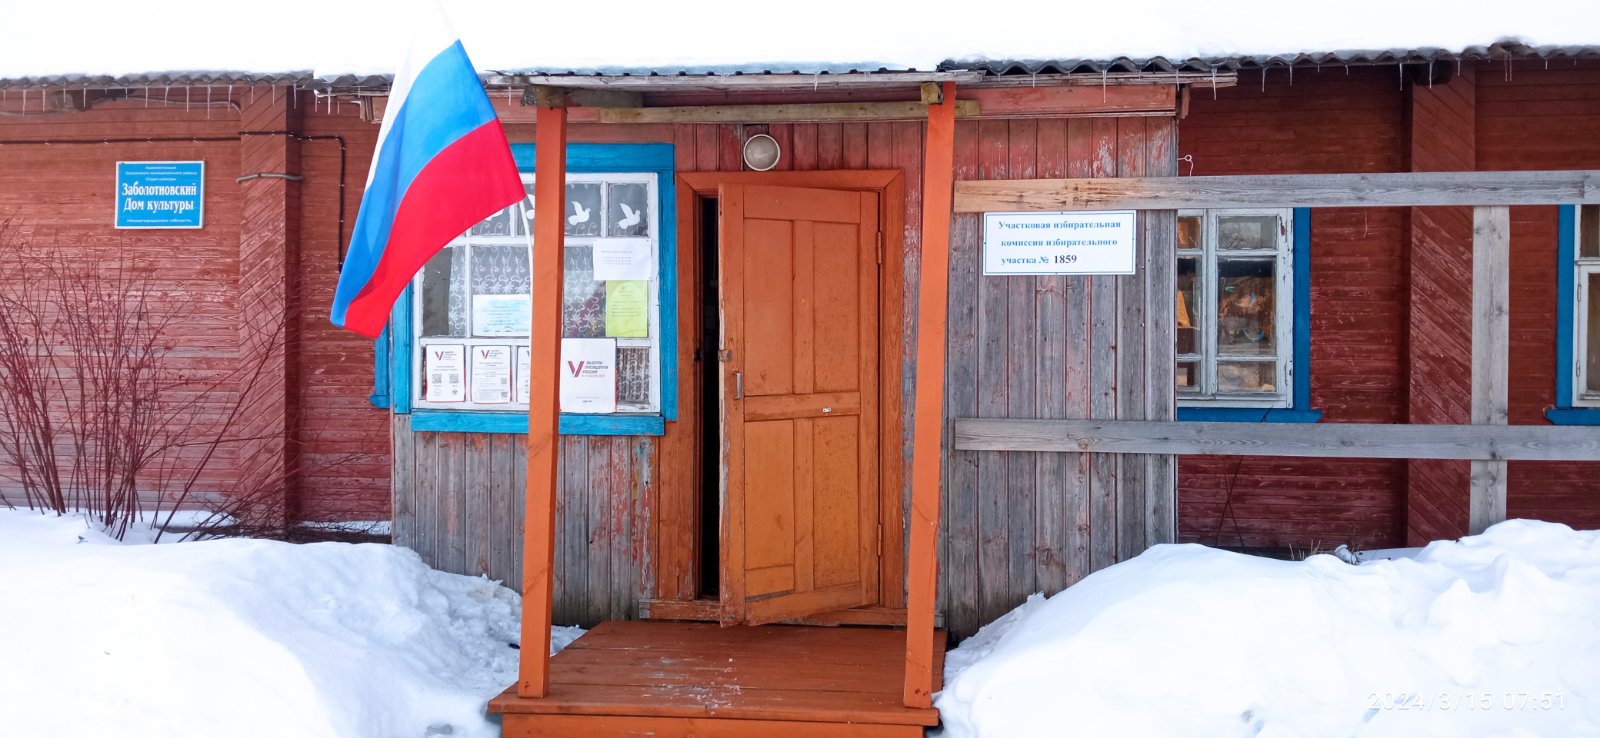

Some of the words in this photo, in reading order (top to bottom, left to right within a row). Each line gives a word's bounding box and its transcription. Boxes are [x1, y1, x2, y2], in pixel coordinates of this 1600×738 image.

[122, 181, 197, 196] Заболотновский
[123, 198, 145, 213] Дом
[146, 200, 195, 214] культуры
[998, 221, 1051, 230] Участковая
[1053, 220, 1121, 230] избирательная
[1001, 239, 1044, 247] комиссии
[1046, 238, 1118, 248] избирательного
[1001, 256, 1037, 265] участка
[1038, 256, 1049, 264] №
[1053, 255, 1078, 264] 1859
